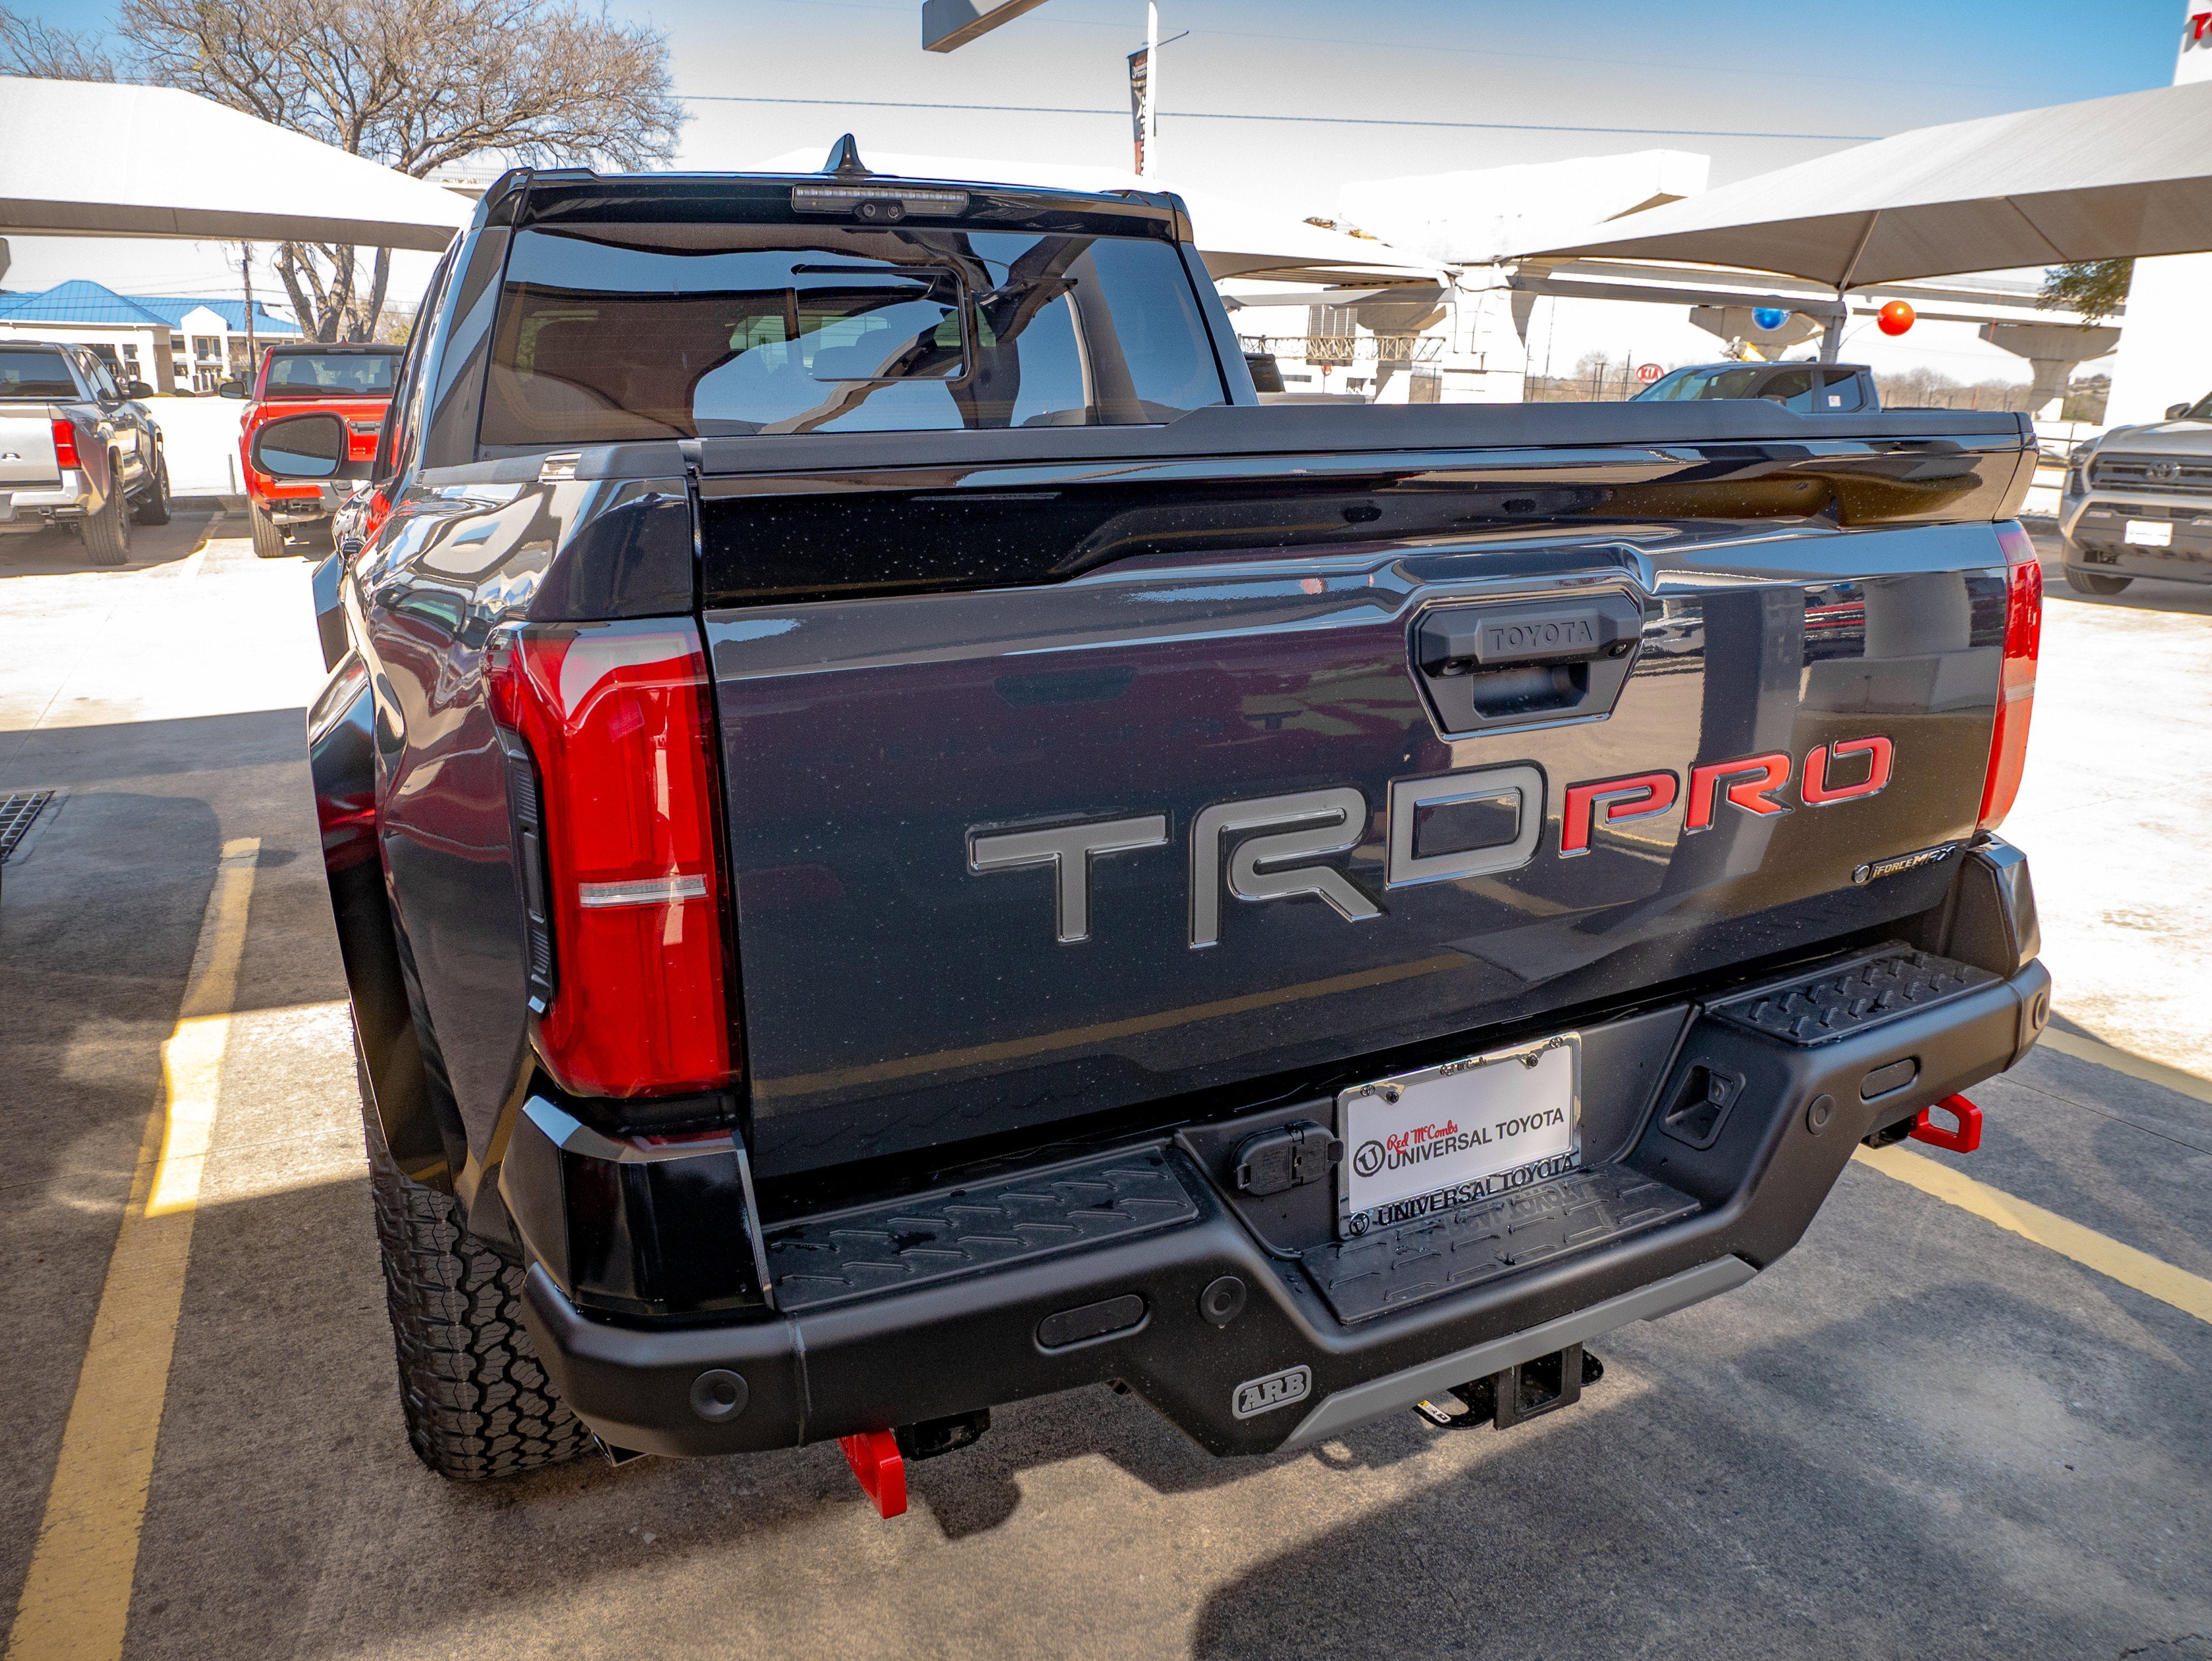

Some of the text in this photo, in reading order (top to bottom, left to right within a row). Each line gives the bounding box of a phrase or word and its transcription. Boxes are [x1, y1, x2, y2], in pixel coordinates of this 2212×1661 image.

[1641, 368, 1659, 379] KIA
[1488, 620, 1593, 651] TOYOTA
[970, 736, 1894, 950] TRD PRO
[1387, 1119, 1458, 1154] Red McCombs
[1388, 1127, 1493, 1170] UNIVERSAL
[1495, 1107, 1564, 1140] TOYOTA
[1378, 1175, 1498, 1226] UNIVERSAL
[1499, 1153, 1574, 1190] TOYOTA
[1241, 1373, 1305, 1412] ARB
